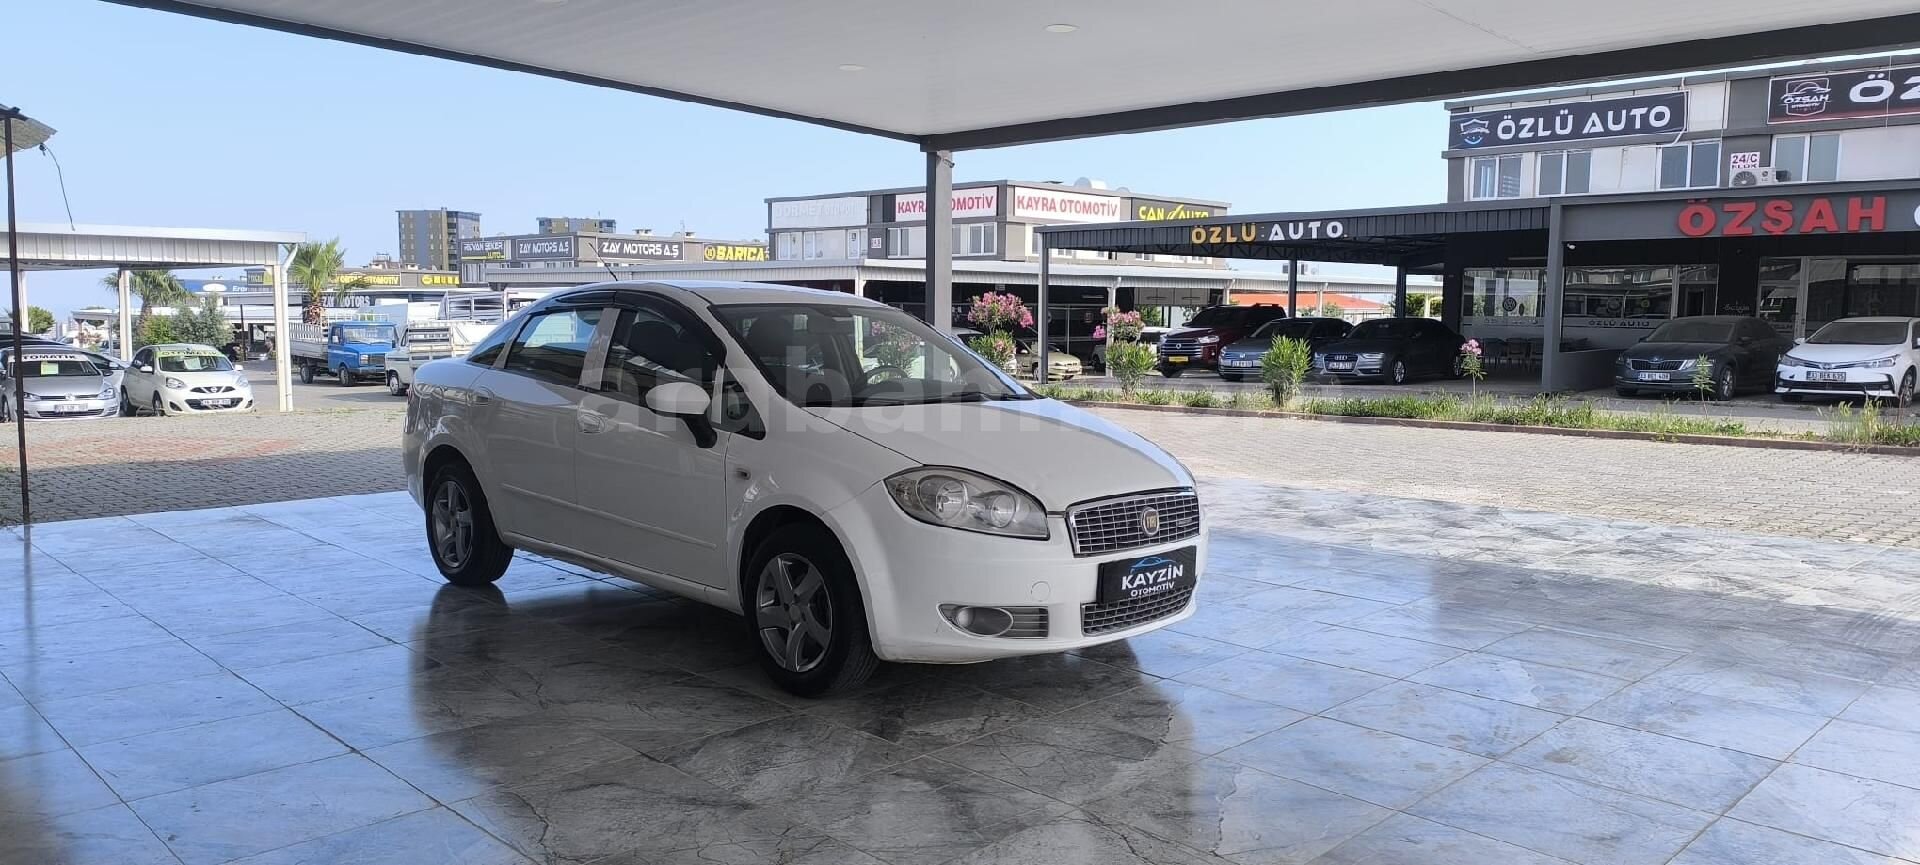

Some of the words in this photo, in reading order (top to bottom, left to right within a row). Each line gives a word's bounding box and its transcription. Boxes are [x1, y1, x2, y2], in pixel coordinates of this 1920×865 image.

[1497, 109, 1574, 140] ÖZLÜ
[1582, 105, 1671, 134] AUTO
[1732, 154, 1758, 164] 24/C
[952, 193, 994, 211] OMOTİV
[1017, 195, 1057, 213] KAYRA
[1060, 198, 1118, 216] OTOMOTİV
[1678, 196, 1887, 238] ÖZŞAH
[1191, 224, 1256, 244] ÖZLÜ
[1268, 221, 1344, 241] AUTO
[520, 243, 531, 254] ZAY
[532, 242, 557, 253] MOTORS
[602, 242, 620, 253] ZAY
[624, 243, 662, 255] MOTORS
[1121, 564, 1184, 590] KAYZİN
[1130, 581, 1175, 597] OTOMOTİV
